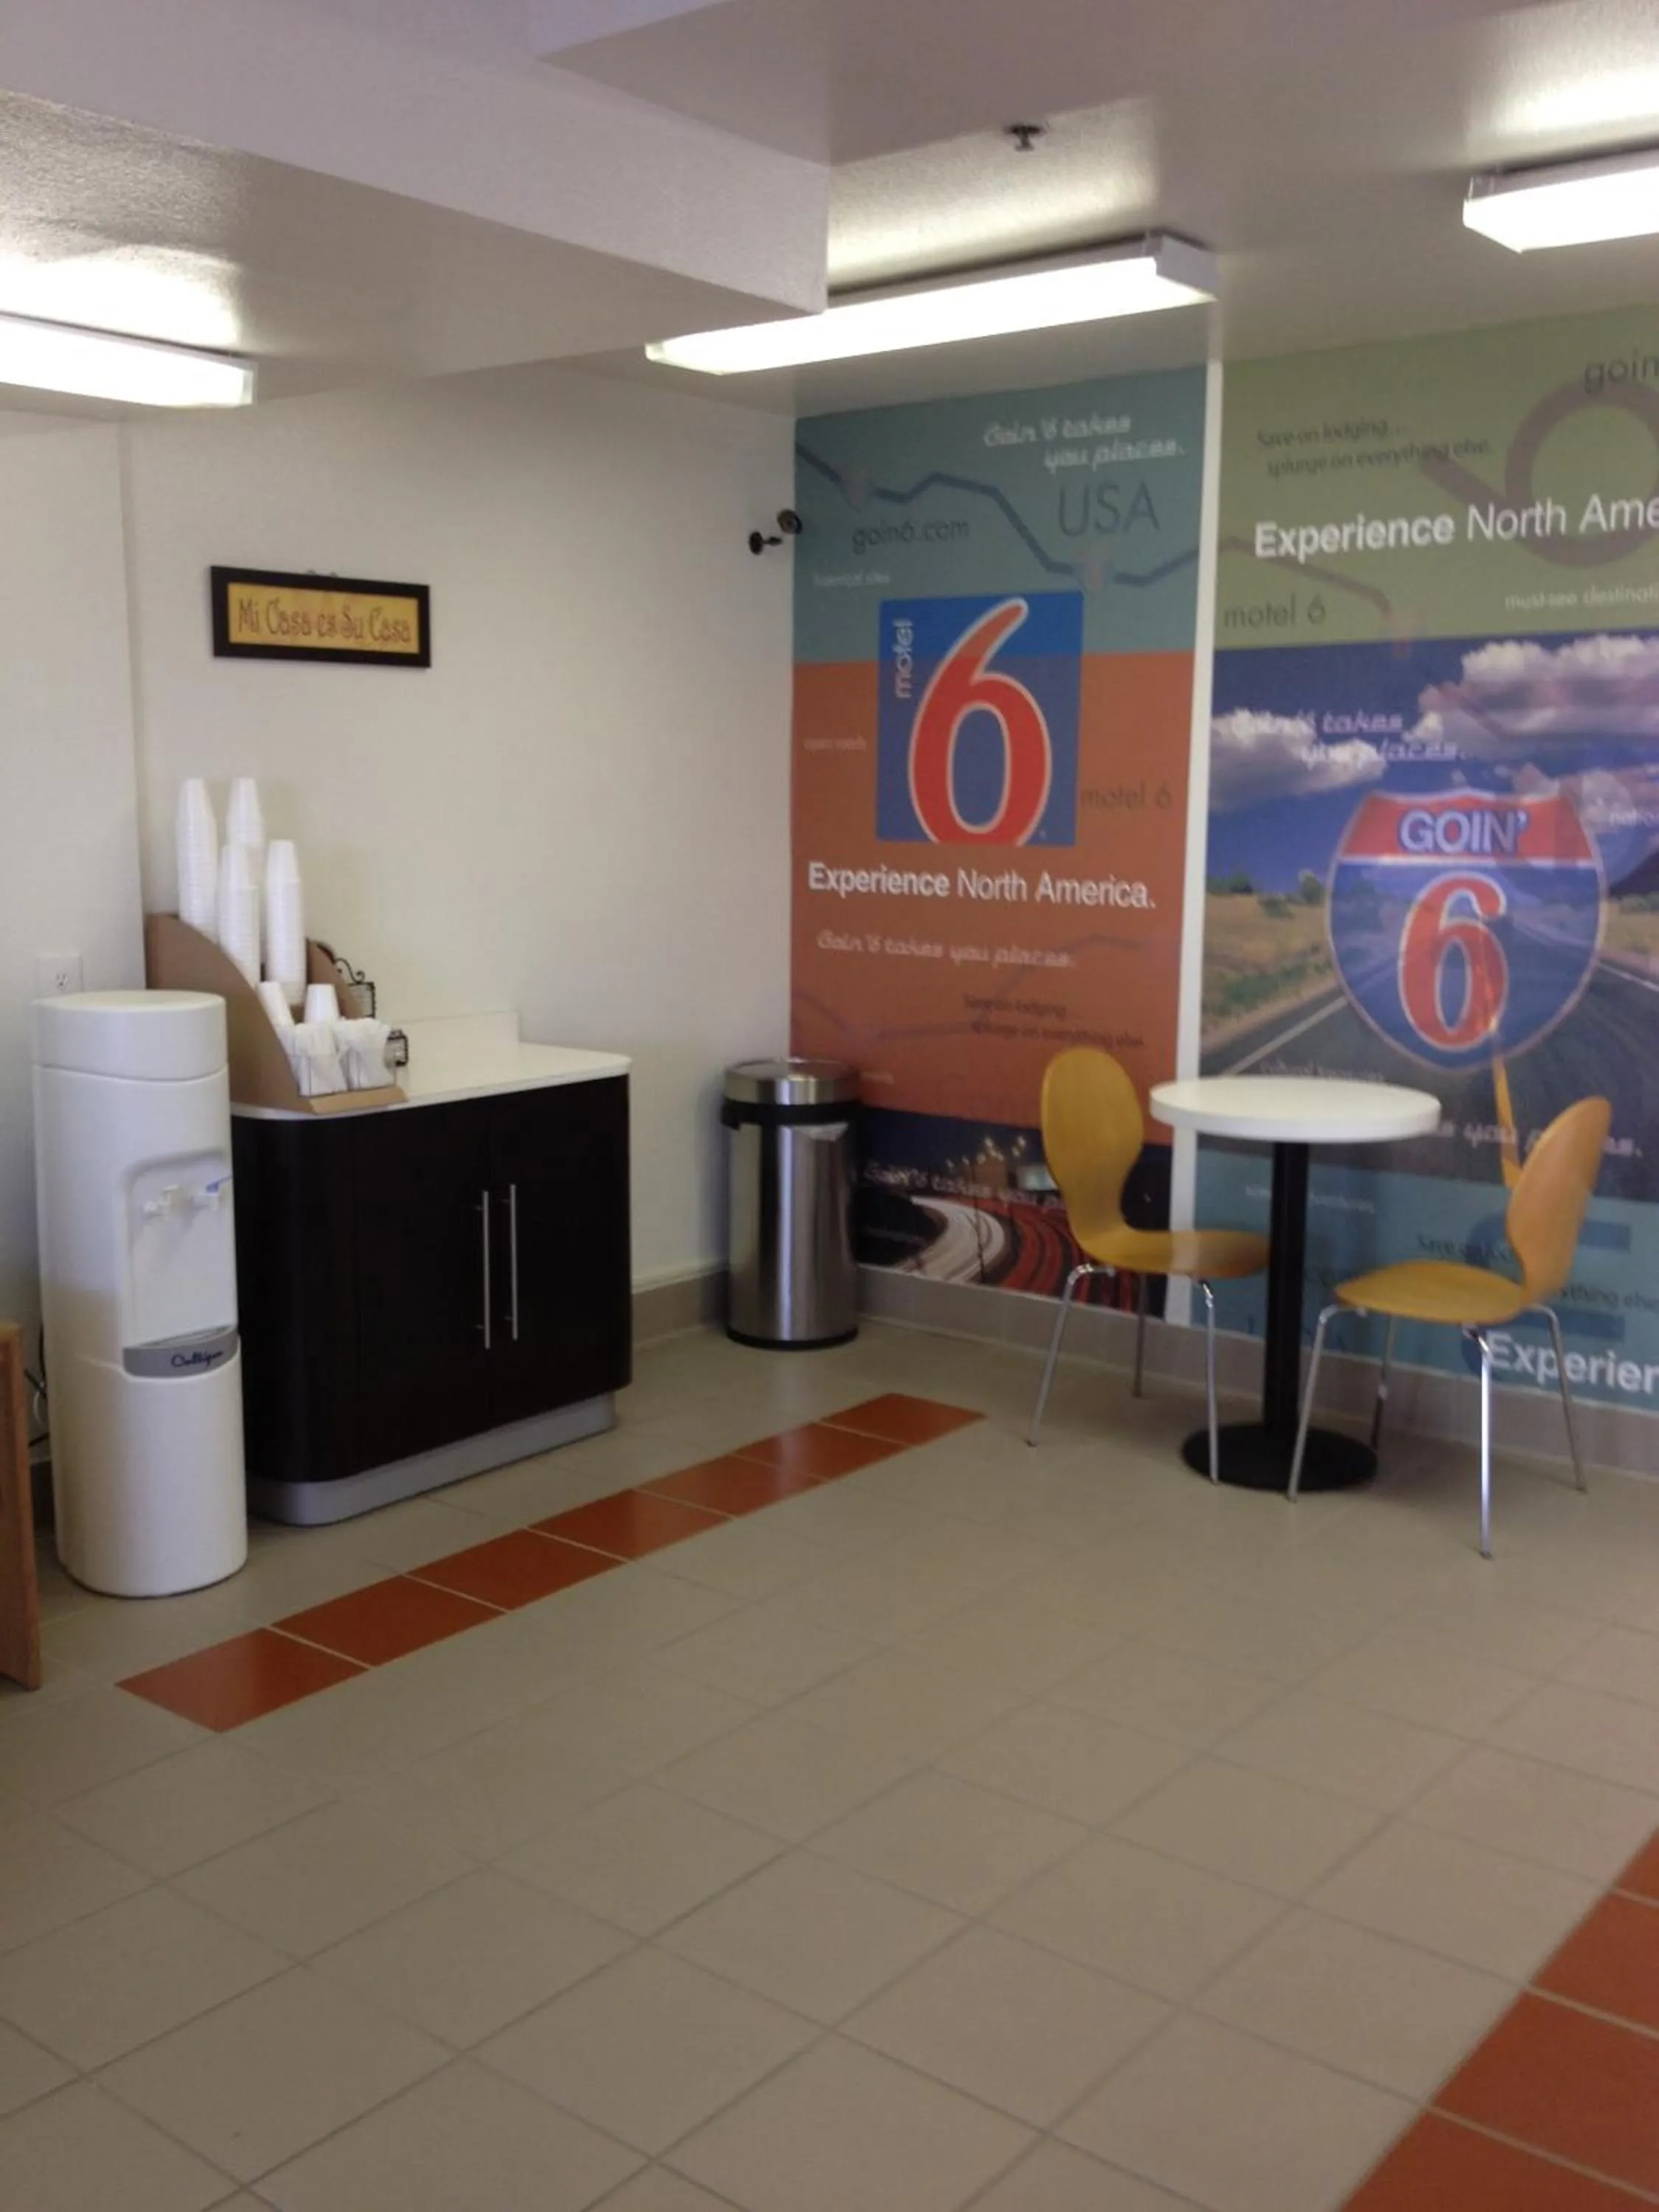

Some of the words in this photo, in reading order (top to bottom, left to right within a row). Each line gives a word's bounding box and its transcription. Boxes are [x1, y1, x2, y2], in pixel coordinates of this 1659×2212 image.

[1058, 479, 1161, 537] USA
[1253, 512, 1455, 563] Experience
[1467, 495, 1567, 541] North
[237, 596, 260, 633] Mi
[265, 596, 313, 636] Casa
[341, 604, 366, 640] Su
[369, 605, 411, 644] Casa
[1223, 594, 1297, 629] motel
[1307, 595, 1326, 625] 6
[893, 619, 914, 699] motel
[908, 597, 1053, 846] 6
[1079, 779, 1145, 810] motel
[1154, 781, 1172, 810] 6
[1399, 810, 1527, 854] GOIN'
[808, 861, 950, 899] Experience
[957, 867, 1029, 902] North
[1034, 870, 1157, 909] America.
[885, 936, 943, 959] takes
[950, 944, 990, 965] you
[1398, 872, 1509, 1051] 6
